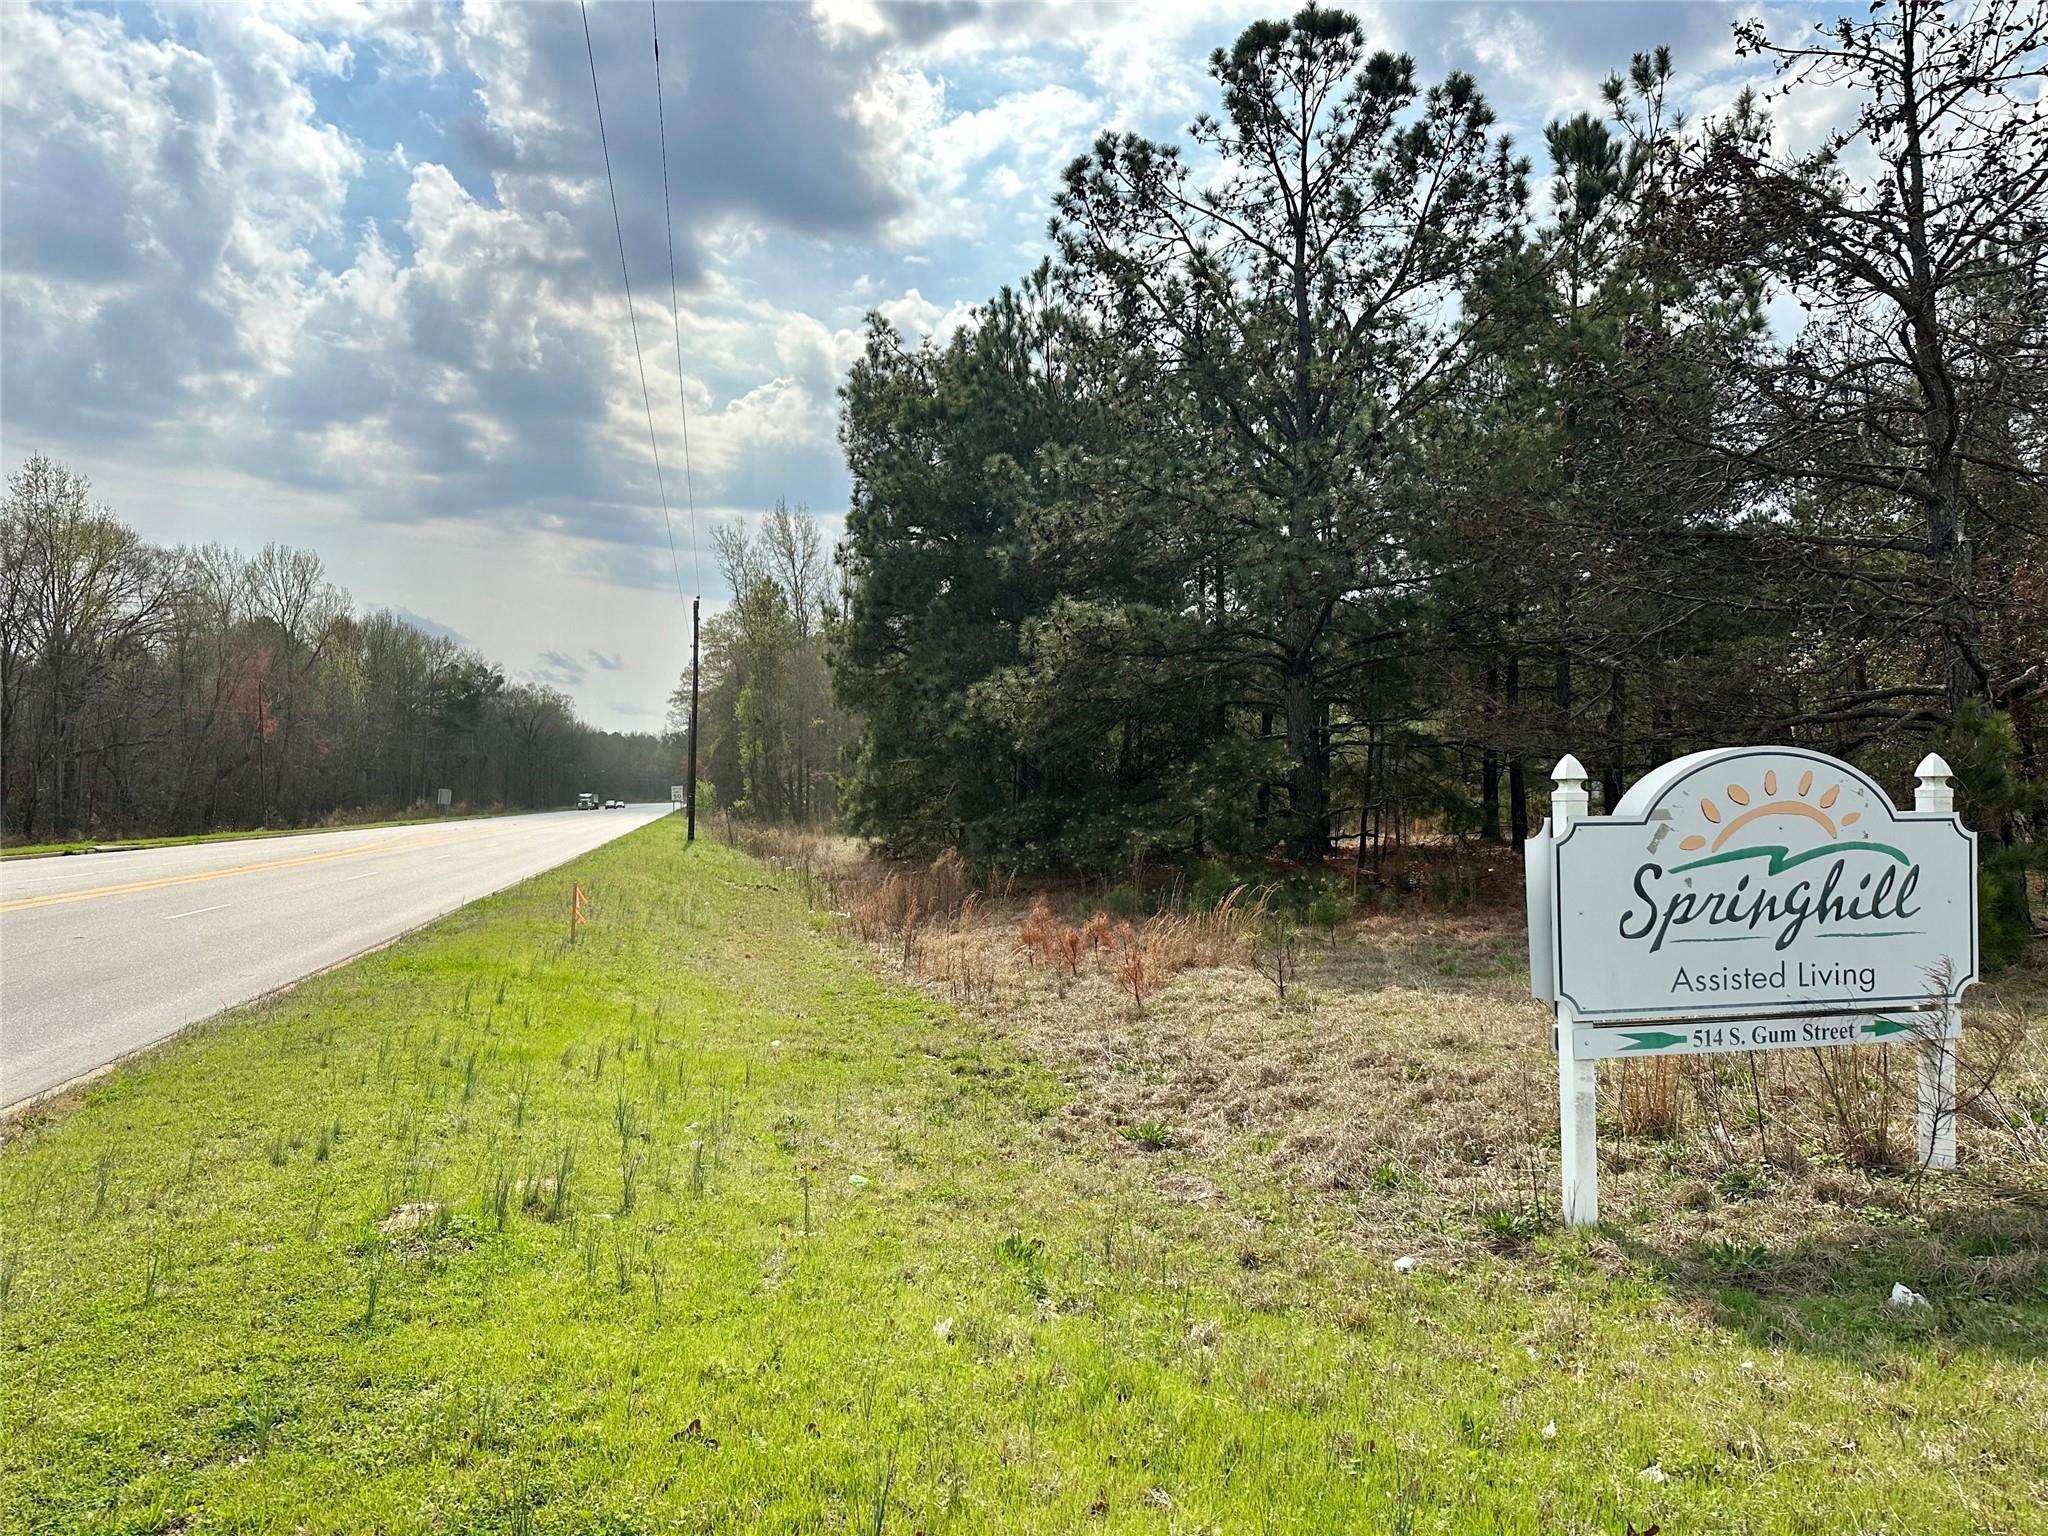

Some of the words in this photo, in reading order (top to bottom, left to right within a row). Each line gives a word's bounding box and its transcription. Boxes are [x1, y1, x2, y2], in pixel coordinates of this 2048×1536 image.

[1619, 858, 1921, 954] Springhill
[1670, 960, 1786, 993] Assisted
[1798, 961, 1876, 993] Living
[1692, 1028, 1723, 1048] 514
[1729, 1027, 1746, 1046] S.
[1751, 1025, 1797, 1045] Gum
[1802, 1023, 1855, 1042] Street
